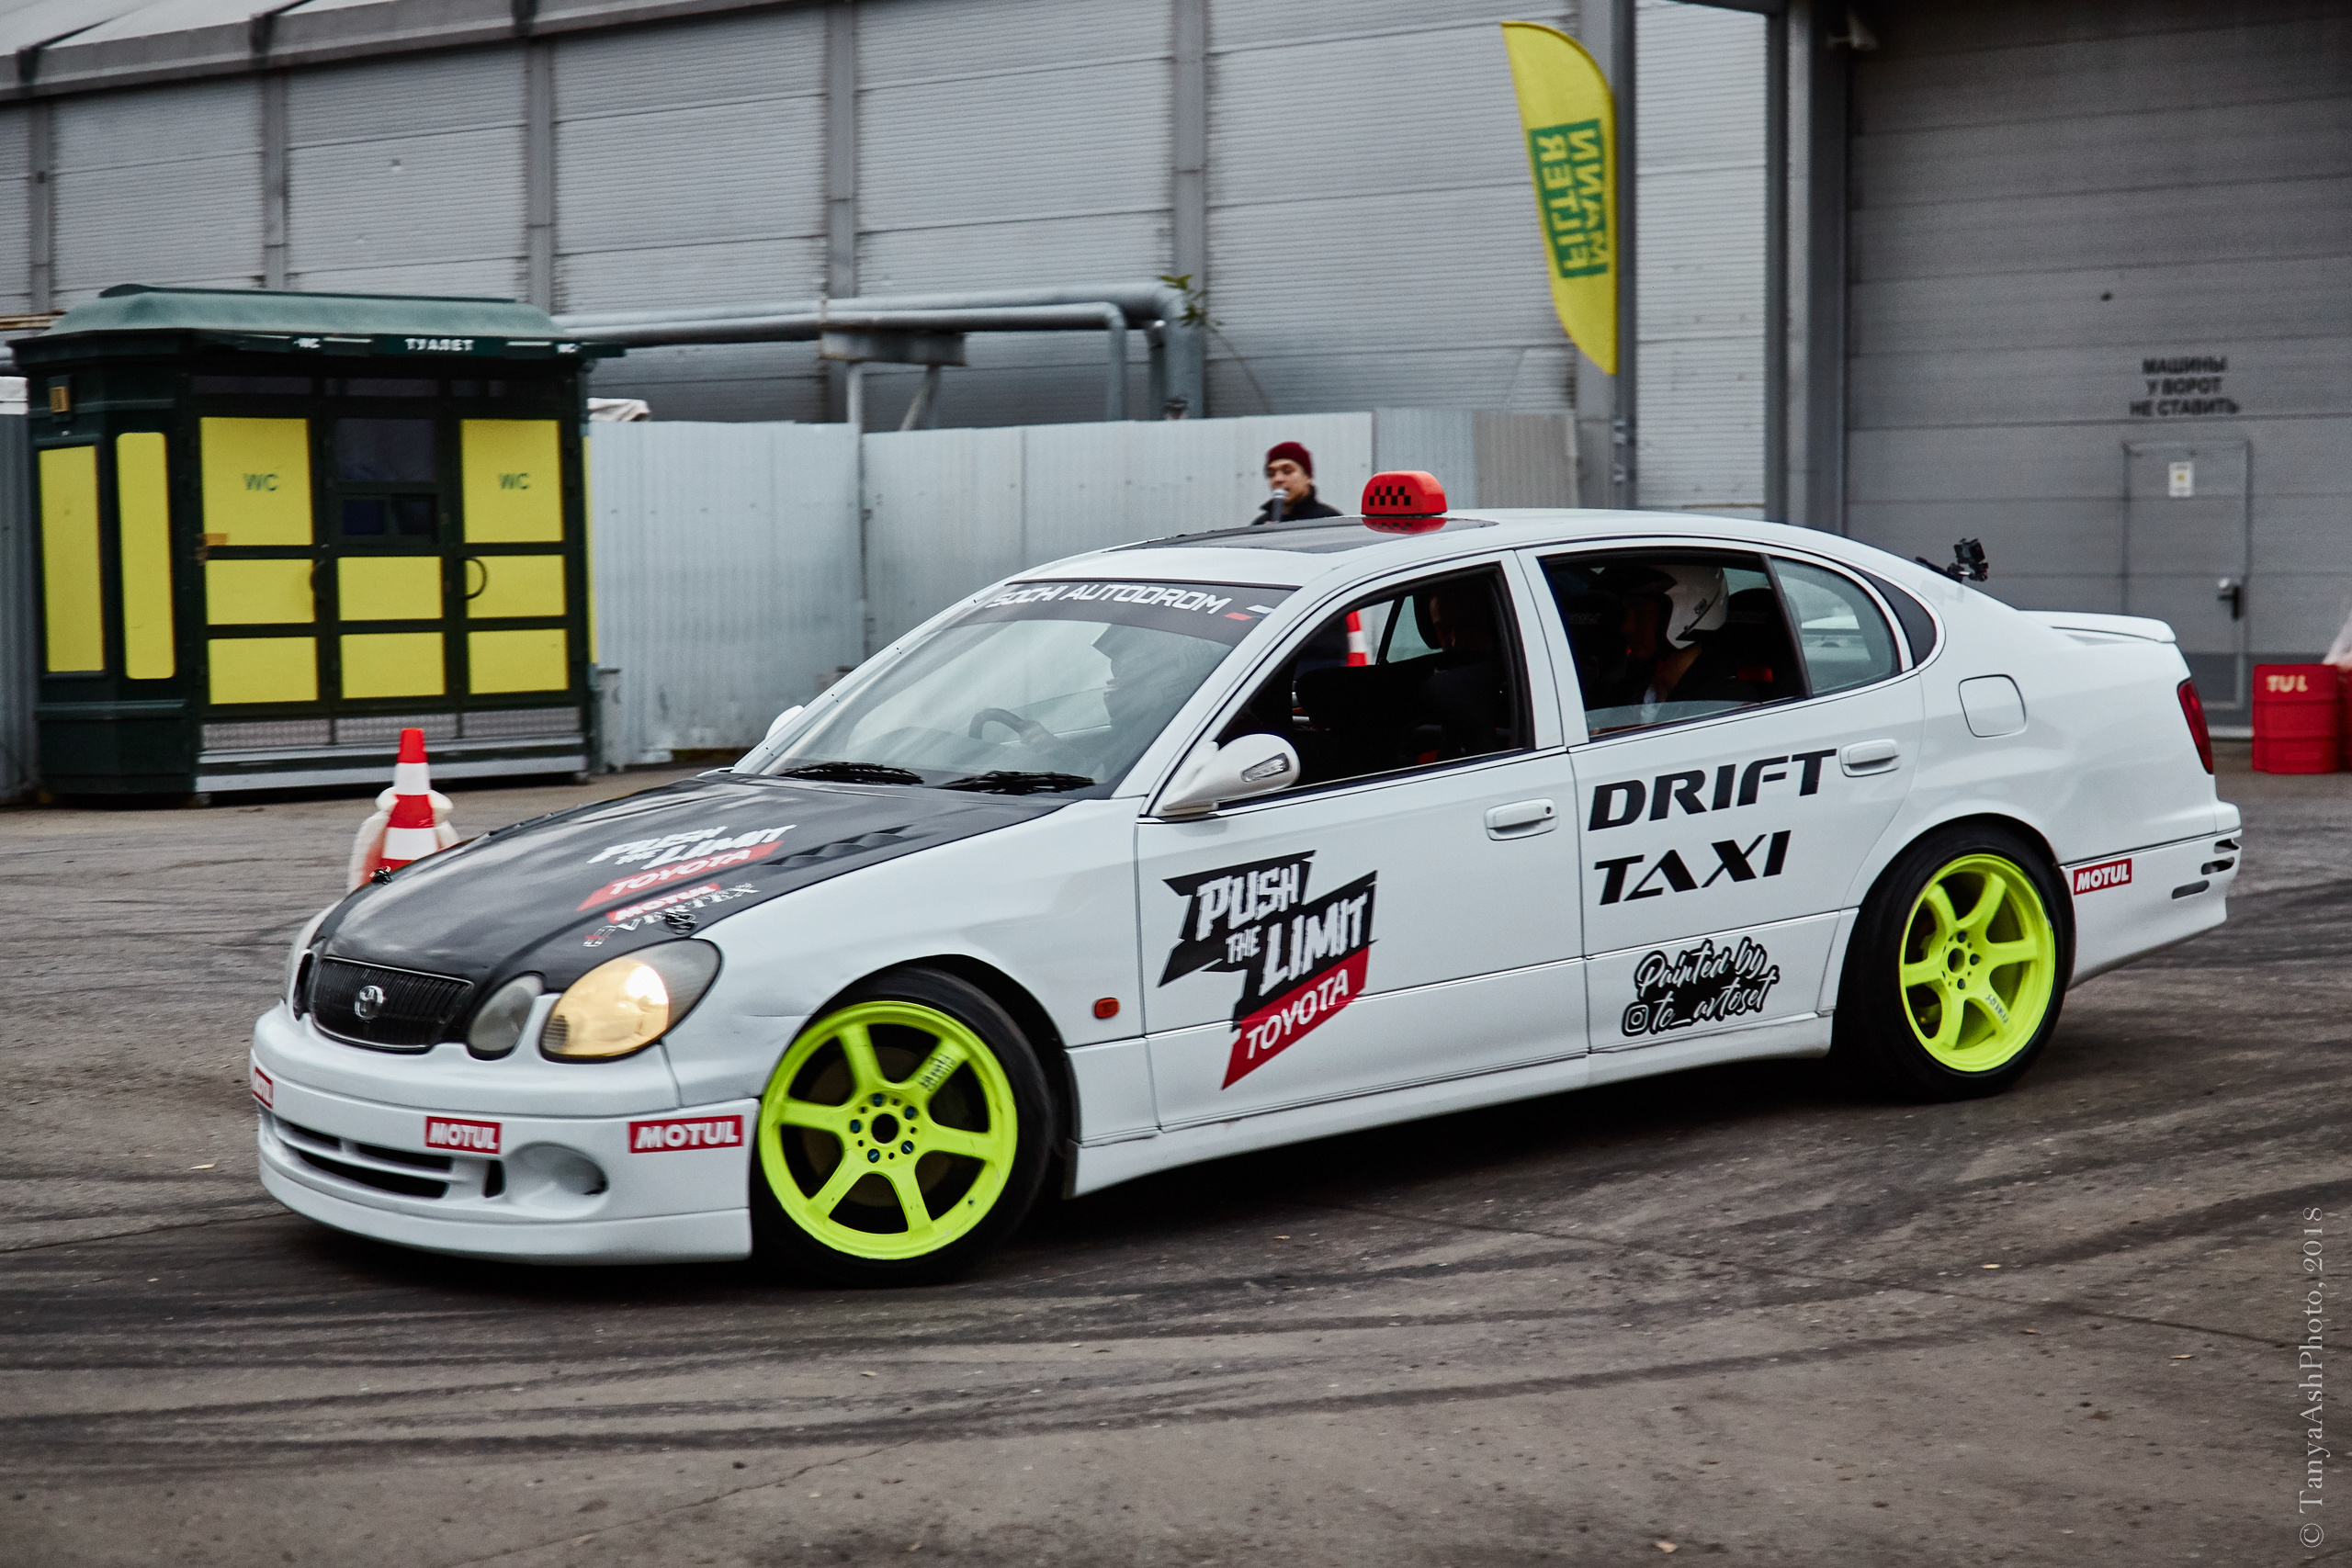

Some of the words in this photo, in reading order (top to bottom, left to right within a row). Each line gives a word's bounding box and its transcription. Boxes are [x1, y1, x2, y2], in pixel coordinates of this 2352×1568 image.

[404, 337, 475, 351] ТУАЛЕТ
[2129, 400, 2154, 416] НЕ
[243, 473, 279, 491] WC
[497, 472, 530, 490] WC
[985, 585, 1069, 608] SOCHI
[1058, 583, 1233, 615] AUTODROM
[1588, 748, 1838, 831] DRIFT
[609, 849, 752, 896] TOYOTA
[1593, 829, 1792, 906] TAXI
[2075, 863, 2130, 892] MOTUL
[613, 884, 717, 921] MOTUL
[1195, 863, 1300, 942] PUSH
[1226, 925, 1261, 964] THE
[1258, 892, 1369, 997] LIMIT
[1637, 942, 1730, 998] Painted
[1735, 940, 1769, 979] by
[1246, 968, 1349, 1059] TOYOTA
[428, 1122, 499, 1150] MOTUL
[636, 1120, 740, 1150] MOTUL
